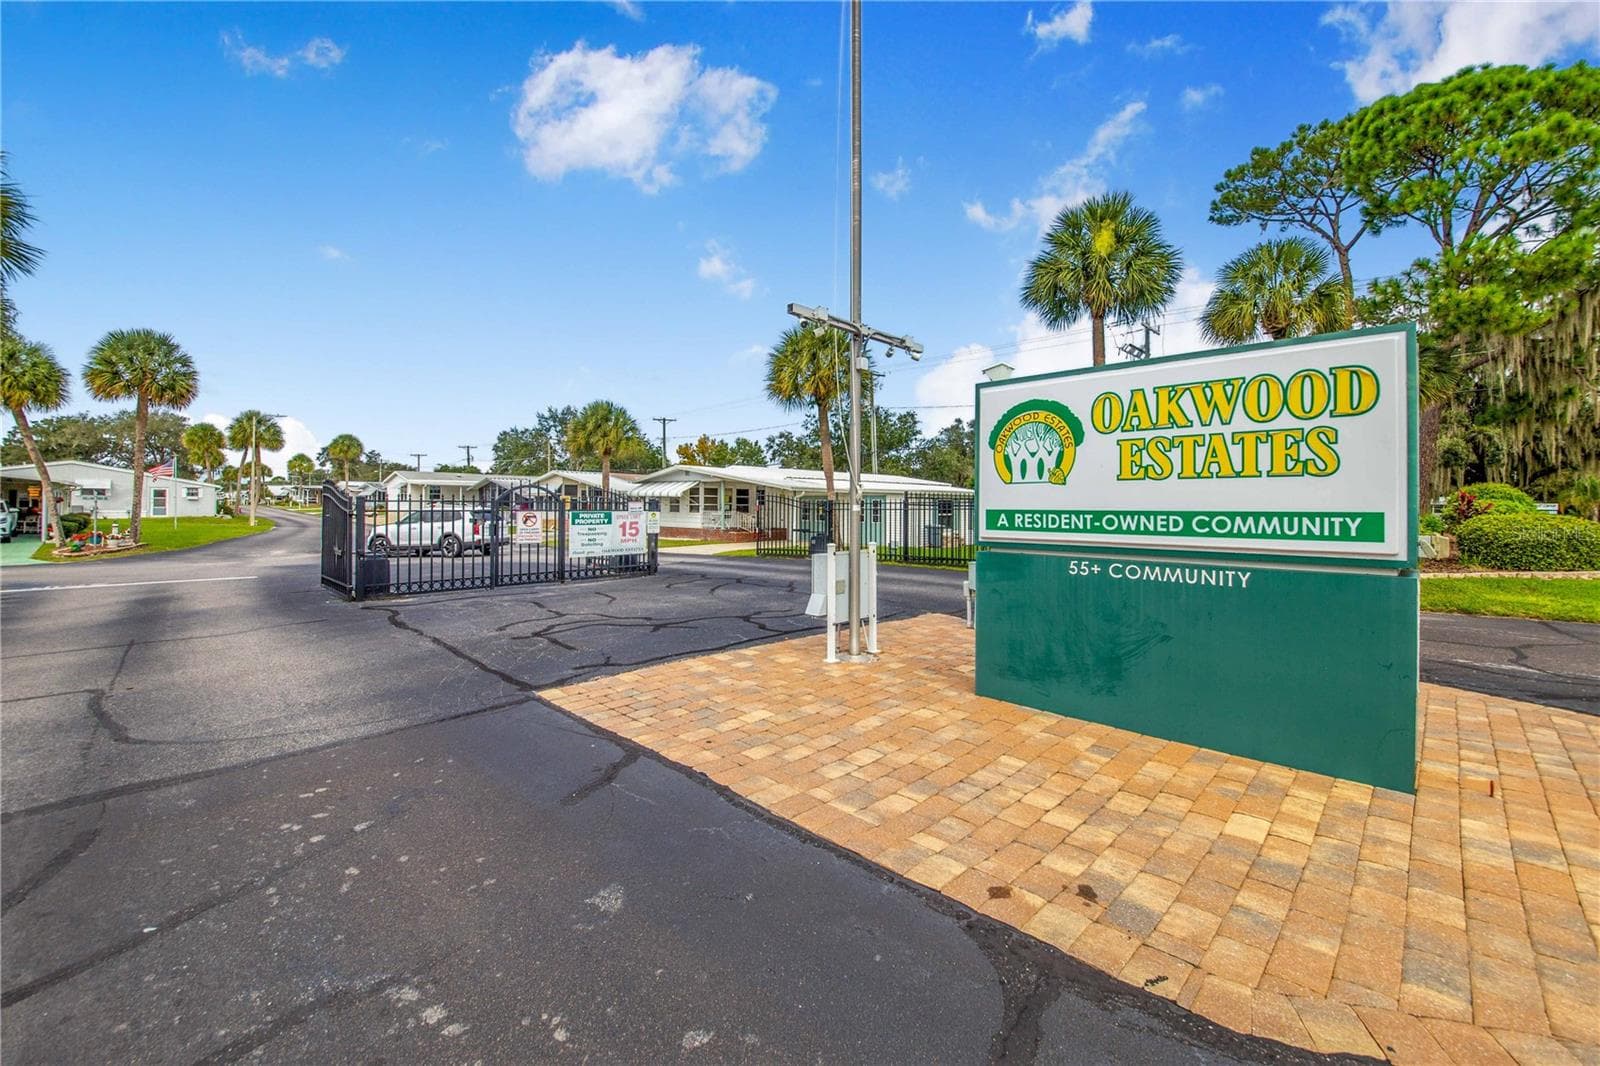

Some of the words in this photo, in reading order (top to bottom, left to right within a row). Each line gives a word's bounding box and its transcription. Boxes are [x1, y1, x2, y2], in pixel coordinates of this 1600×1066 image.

[1092, 365, 1380, 434] OAKWOOD
[996, 412, 1040, 453] OAKWOOD
[1044, 414, 1073, 448] ESTATES
[1117, 427, 1340, 480] ESTATES
[619, 521, 640, 537] 15
[998, 513, 1008, 527] A
[1014, 513, 1184, 533] RESIDENT-OWNED
[1191, 515, 1362, 538] COMMUNITY
[1069, 560, 1101, 576] 55+
[1109, 562, 1251, 589] COMMUNITY
